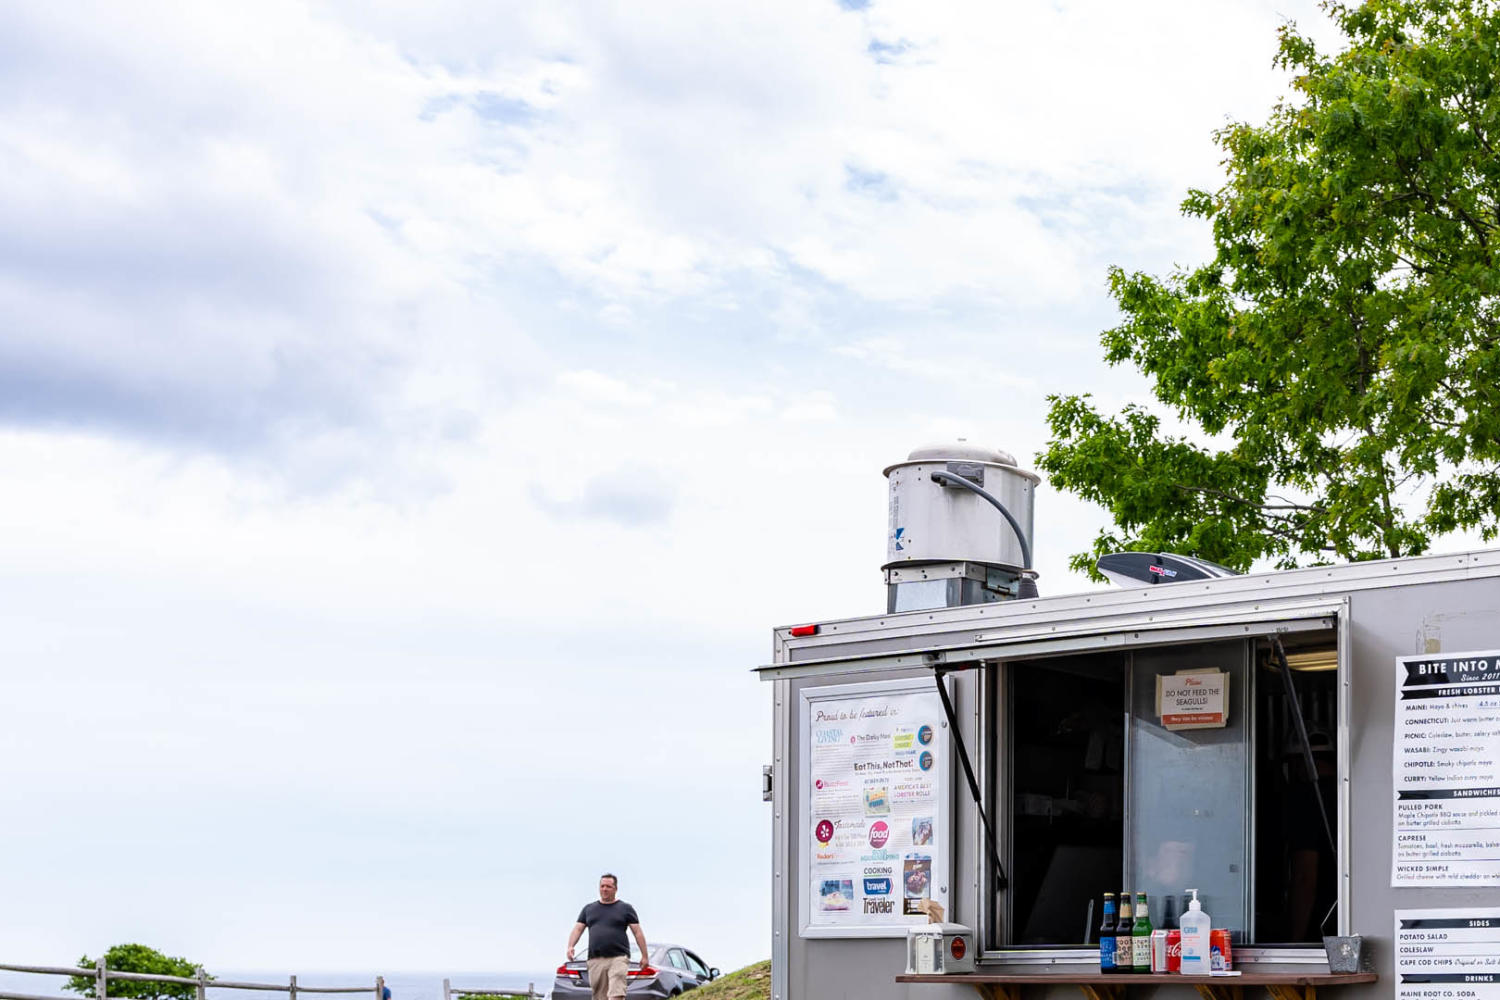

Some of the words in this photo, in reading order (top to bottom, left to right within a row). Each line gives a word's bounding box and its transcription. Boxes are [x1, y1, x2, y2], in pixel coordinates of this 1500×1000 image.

[1419, 663, 1447, 675] BITE
[1453, 660, 1488, 672] INTO
[1461, 674, 1479, 682] Since
[1177, 689, 1191, 697] NOT
[1438, 688, 1461, 696] FRESH
[1463, 687, 1496, 695] LOBSTER
[816, 710, 838, 722] Proud
[854, 763, 866, 771] Eat
[883, 761, 895, 770] Not
[1453, 789, 1500, 797] SANDWICHES
[869, 827, 888, 841] food
[866, 881, 887, 890] travel
[863, 897, 895, 914] Traveler
